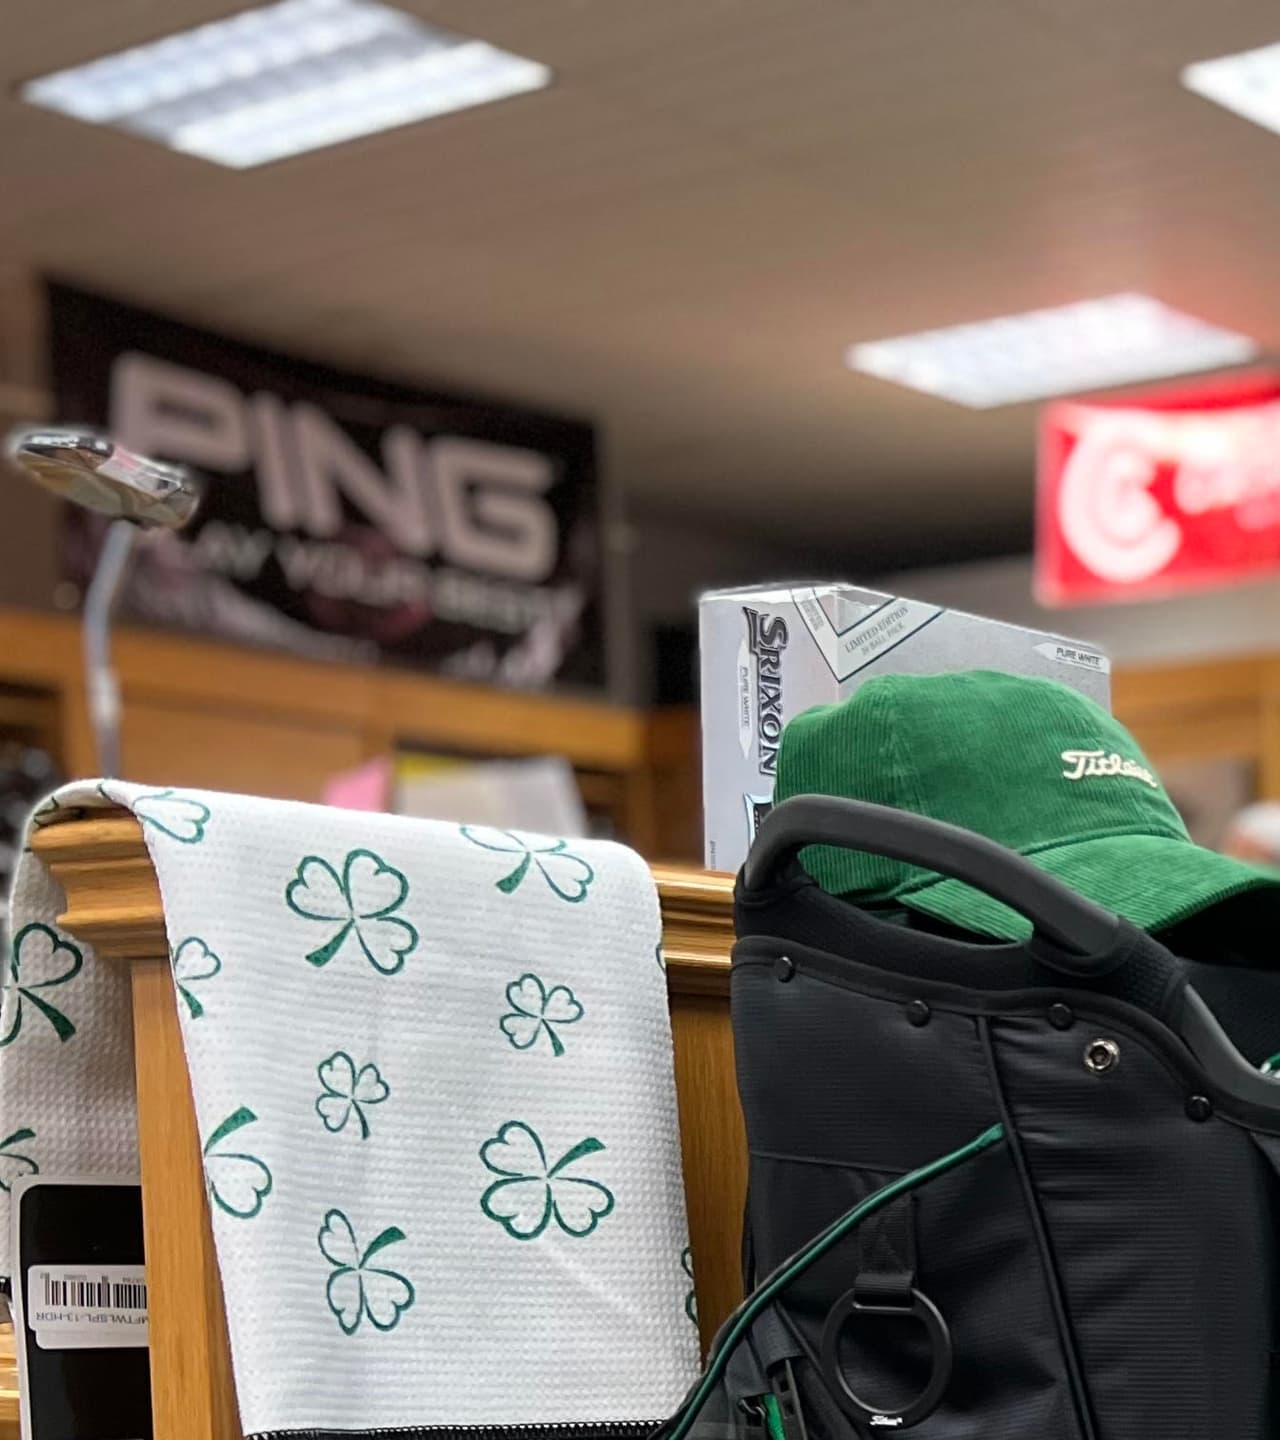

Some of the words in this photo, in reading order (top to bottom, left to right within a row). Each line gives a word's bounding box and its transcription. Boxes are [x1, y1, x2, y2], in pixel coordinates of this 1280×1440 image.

[110, 350, 562, 583] PING
[756, 611, 788, 776] SRIXON
[1056, 647, 1077, 660] PURE
[1078, 651, 1103, 666] WHITE
